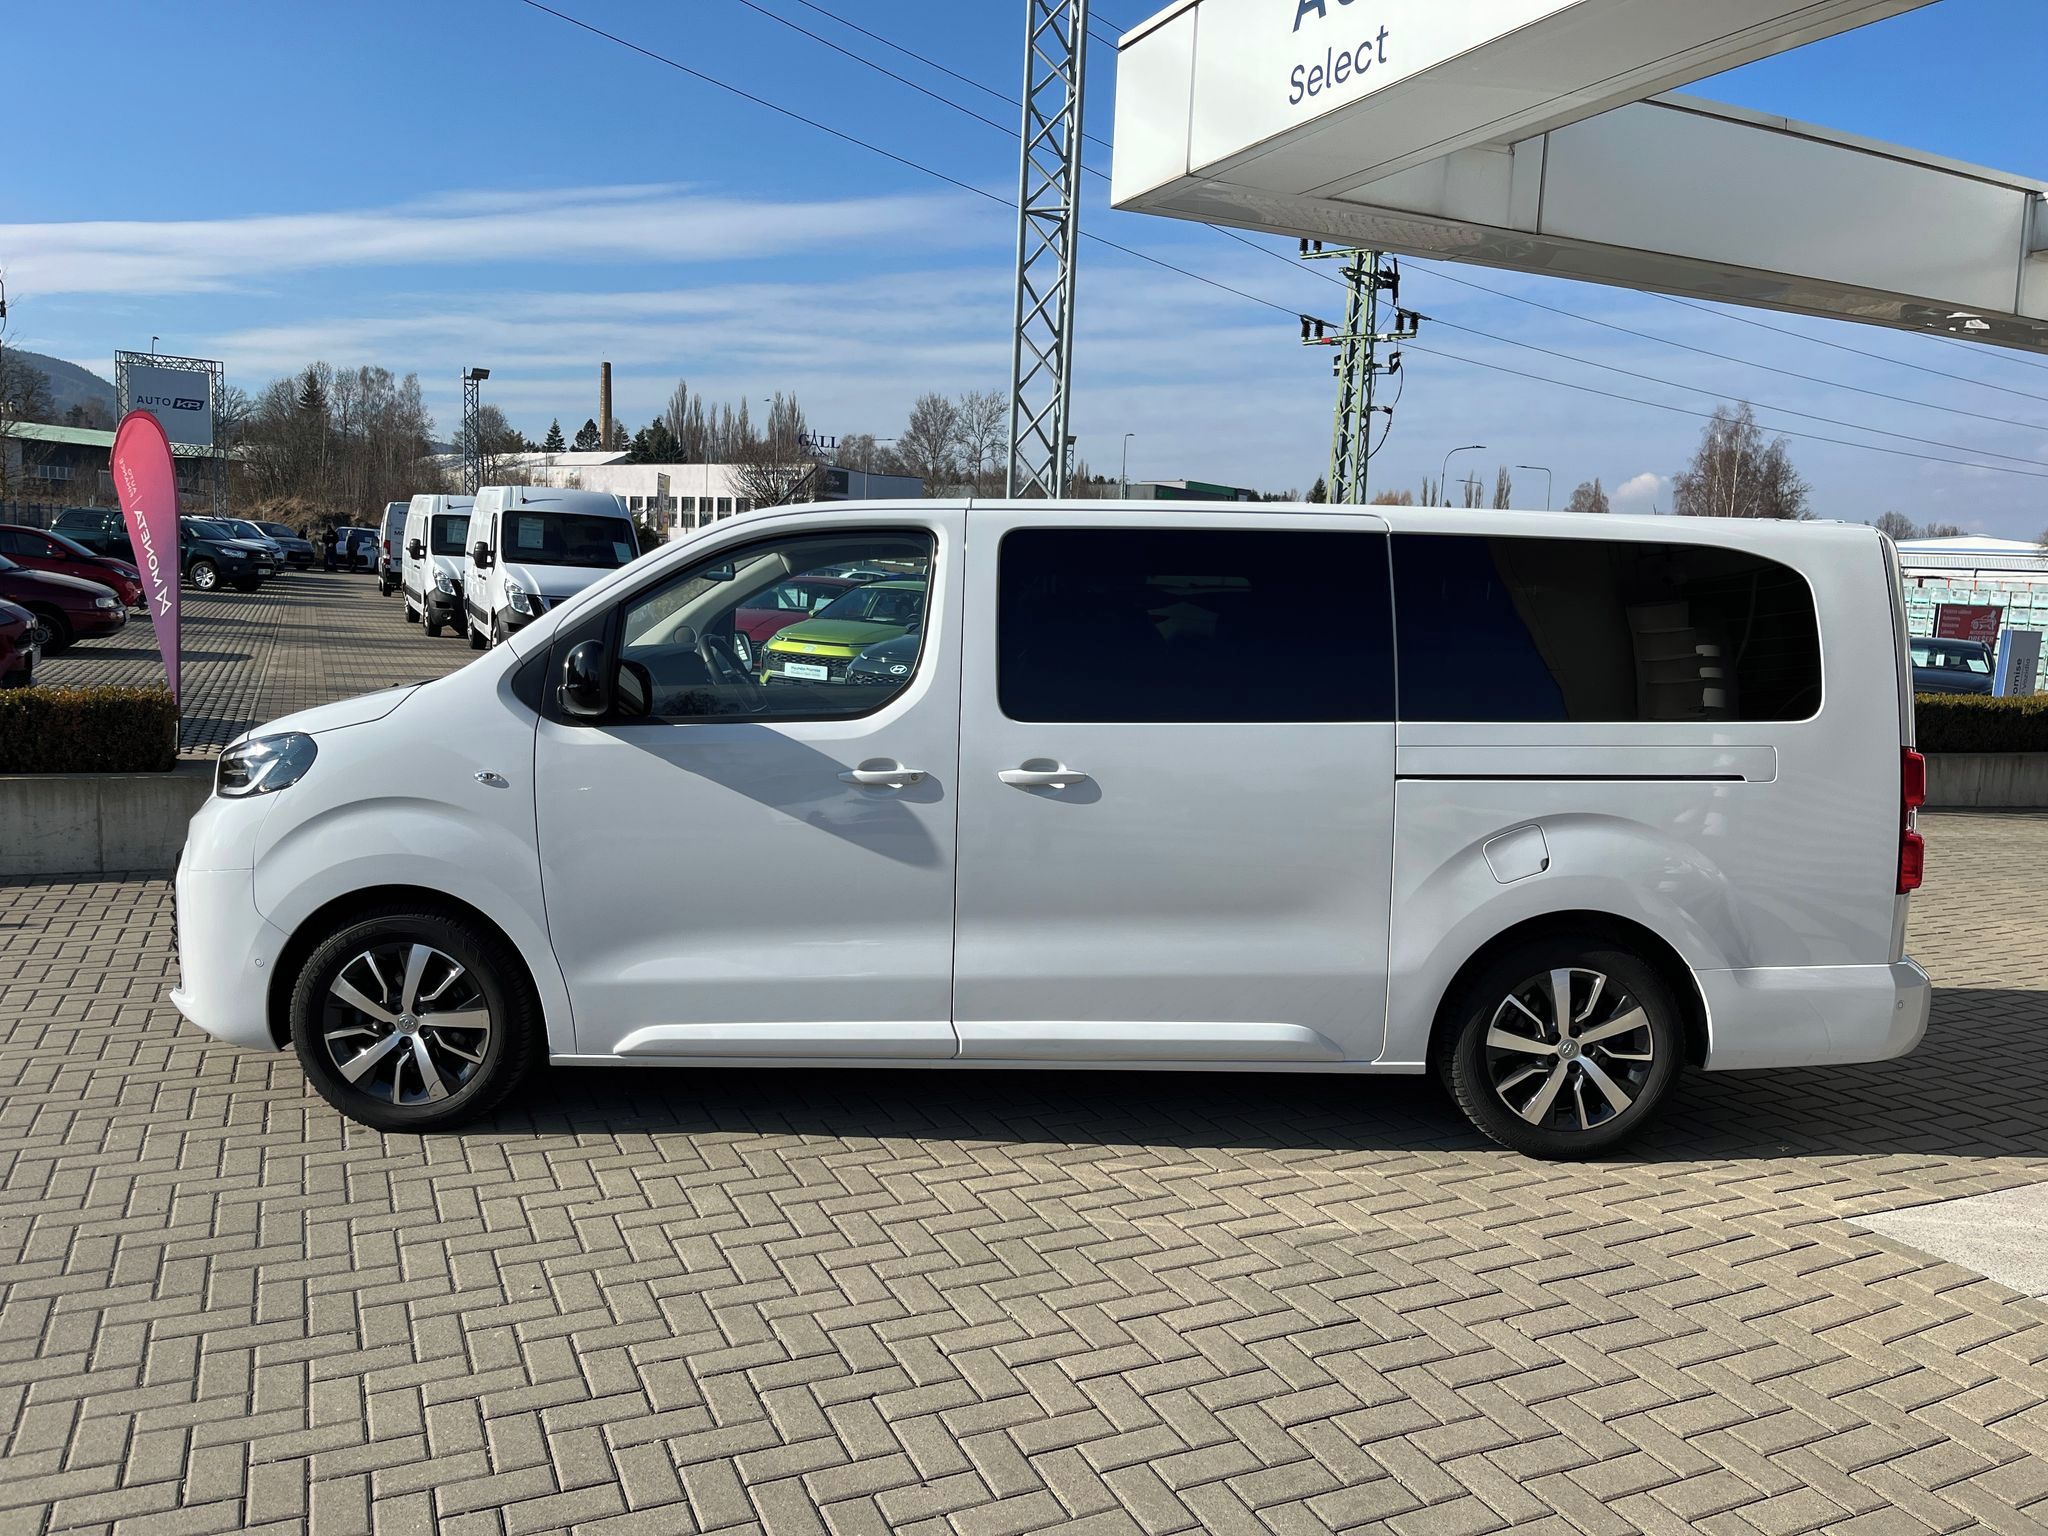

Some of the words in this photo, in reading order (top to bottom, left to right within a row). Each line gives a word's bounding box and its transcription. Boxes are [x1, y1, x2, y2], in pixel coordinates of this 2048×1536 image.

[1289, 25, 1389, 105] Select
[136, 395, 171, 406] AUTO
[799, 429, 841, 456] GALL
